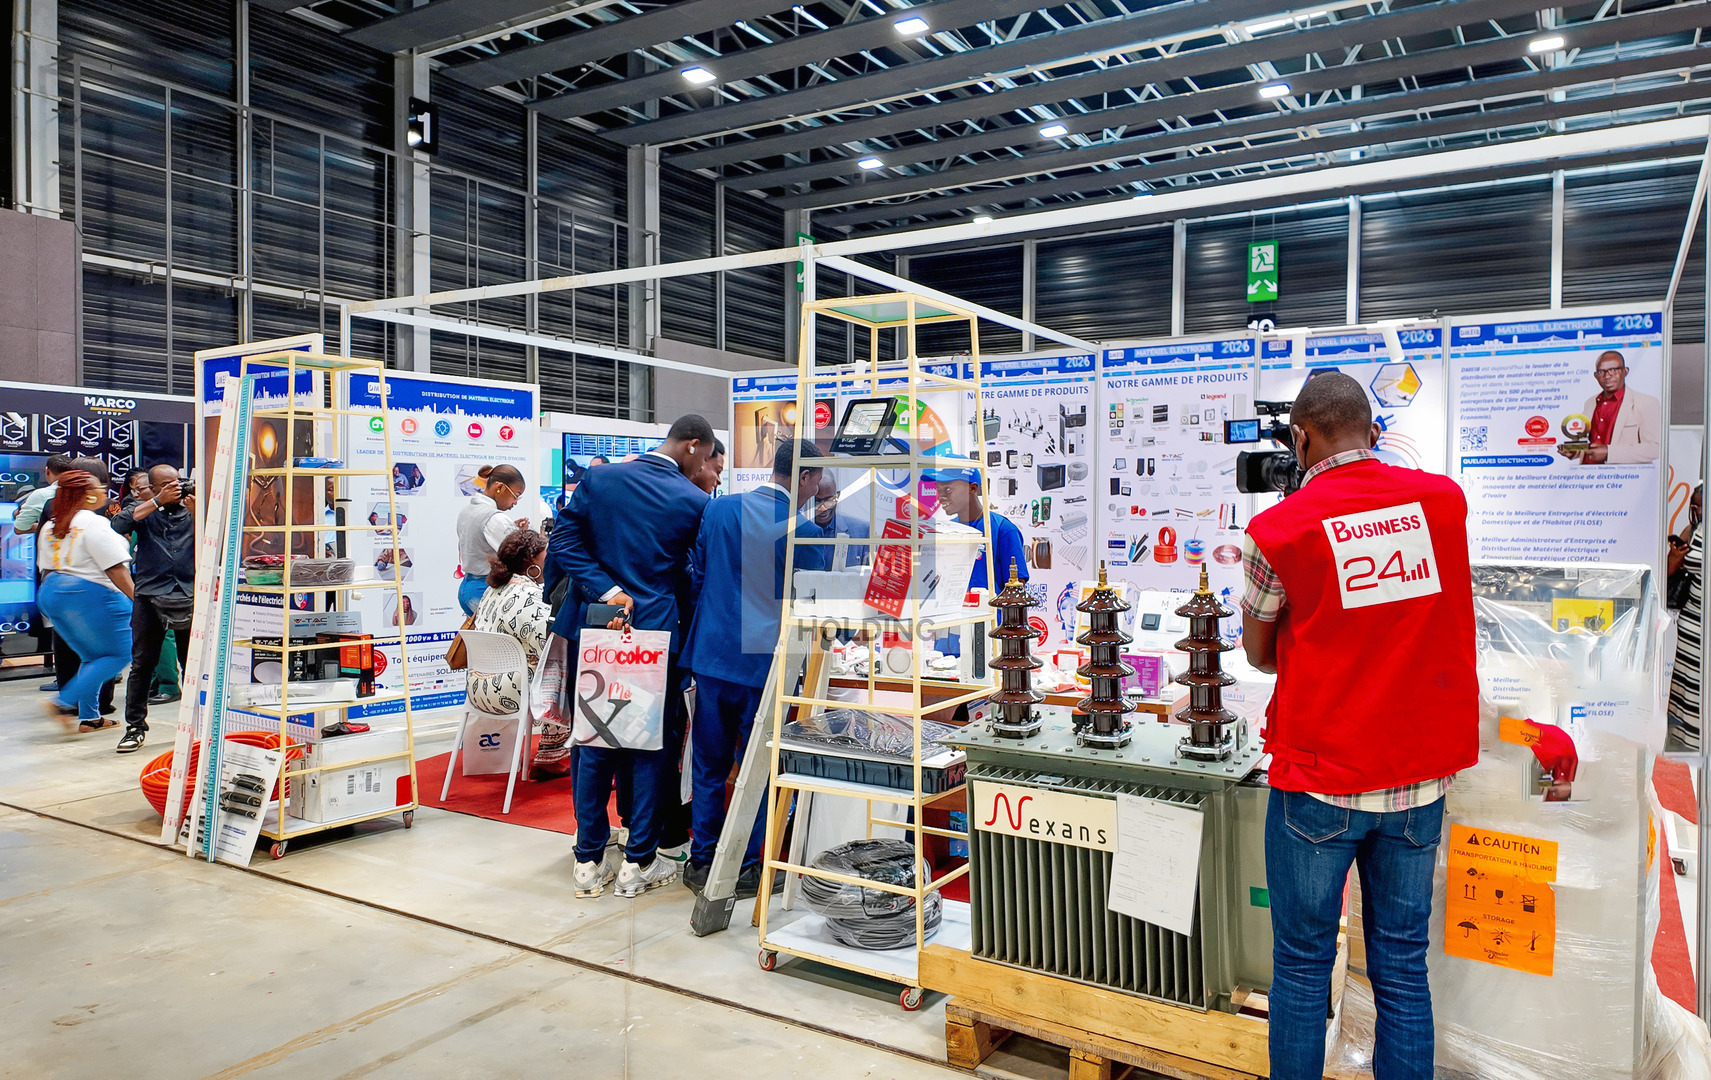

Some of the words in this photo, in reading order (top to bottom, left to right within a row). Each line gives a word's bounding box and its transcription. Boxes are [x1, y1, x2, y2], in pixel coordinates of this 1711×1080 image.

[1613, 314, 1653, 331] 2026
[1401, 330, 1434, 344] 2026
[1221, 341, 1250, 354] 2026
[1065, 356, 1091, 368] 2026
[931, 366, 953, 376] 2026
[1107, 378, 1139, 389] NOTRE
[1141, 376, 1178, 387] GAMME
[1181, 375, 1193, 385] DE
[1197, 372, 1248, 383] PRODUITS
[421, 391, 460, 399] DISTRIBUTION
[997, 388, 1029, 398] GAMME
[1031, 387, 1042, 397] DE
[1044, 385, 1089, 396] PRODUITS
[1206, 393, 1227, 401] legrand
[84, 396, 137, 410] MARCO
[736, 473, 750, 482] DES
[1331, 515, 1421, 543] BUSINESS
[1343, 550, 1407, 592] 24
[392, 656, 411, 664] Tot
[583, 644, 663, 665] drocolor
[984, 792, 1107, 845] Nexans
[1483, 836, 1540, 856] CAUTION
[1453, 848, 1512, 865] TRANSPORTATION
[1482, 913, 1515, 925] STORAGE
